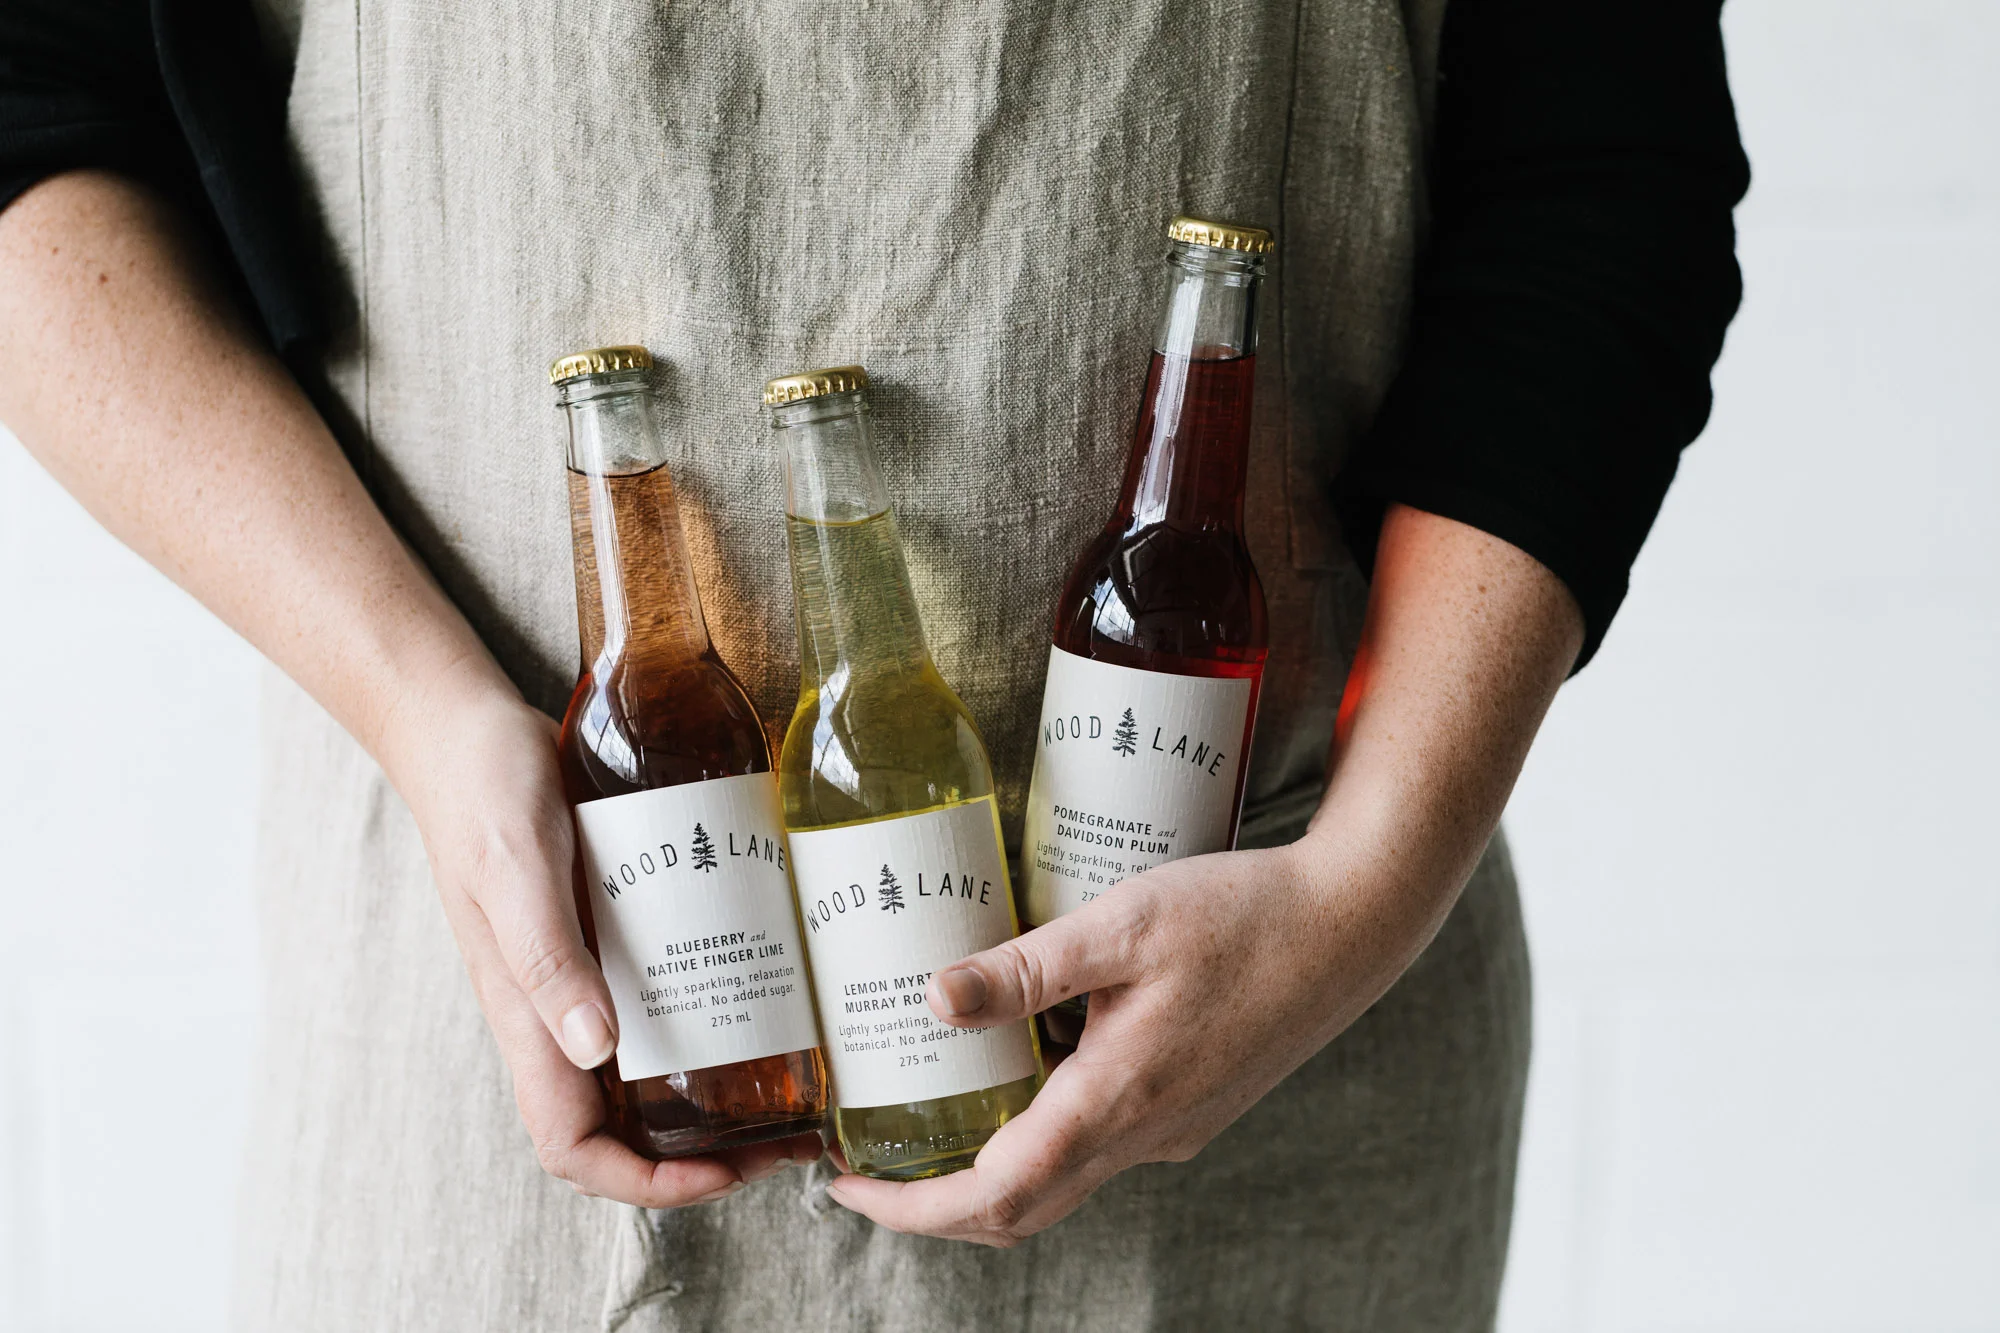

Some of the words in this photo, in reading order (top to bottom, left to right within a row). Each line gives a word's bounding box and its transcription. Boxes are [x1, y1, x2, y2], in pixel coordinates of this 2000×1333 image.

[1044, 715, 1102, 747] WOOD
[1151, 726, 1226, 777] LANE
[1053, 804, 1153, 836] POMEGRANATE
[1157, 828, 1178, 839] and
[1057, 824, 1125, 850] DAVIDSON
[1130, 839, 1169, 855] PLUM
[602, 843, 678, 900] WOOD
[729, 832, 785, 872] LANE
[1036, 839, 1066, 861] Lightly
[1068, 851, 1126, 873] sparkling,
[1131, 862, 1153, 874] rel
[1036, 856, 1083, 880] botanical.
[1088, 871, 1104, 884] No
[806, 883, 866, 934] WOOD
[918, 872, 992, 906] LANE
[1081, 891, 1099, 902] 27
[666, 931, 746, 956] BLUEBERRY
[750, 930, 766, 942] and
[647, 958, 698, 978] NATIVE
[704, 948, 755, 968] FINGER
[759, 943, 785, 959] LIME
[640, 985, 679, 1002] Lightly
[684, 975, 746, 996] sparkling,
[749, 965, 795, 983] relaxation
[844, 979, 888, 996] LEMON
[894, 971, 937, 989] MYRT
[647, 997, 707, 1018] botanical.
[711, 994, 728, 1007] No
[733, 985, 767, 1003] added
[770, 982, 796, 998] sugar.
[844, 996, 896, 1014] MURRAY
[903, 992, 928, 1006] RO
[711, 1014, 732, 1028] 275
[736, 1011, 752, 1023] mL
[838, 1022, 870, 1038] Lightly
[874, 1014, 934, 1034] sparkling,
[844, 1037, 895, 1053] botanical.
[899, 1035, 916, 1047] No
[921, 1026, 957, 1044] added
[899, 1054, 920, 1067] 275
[924, 1051, 941, 1064] mL
